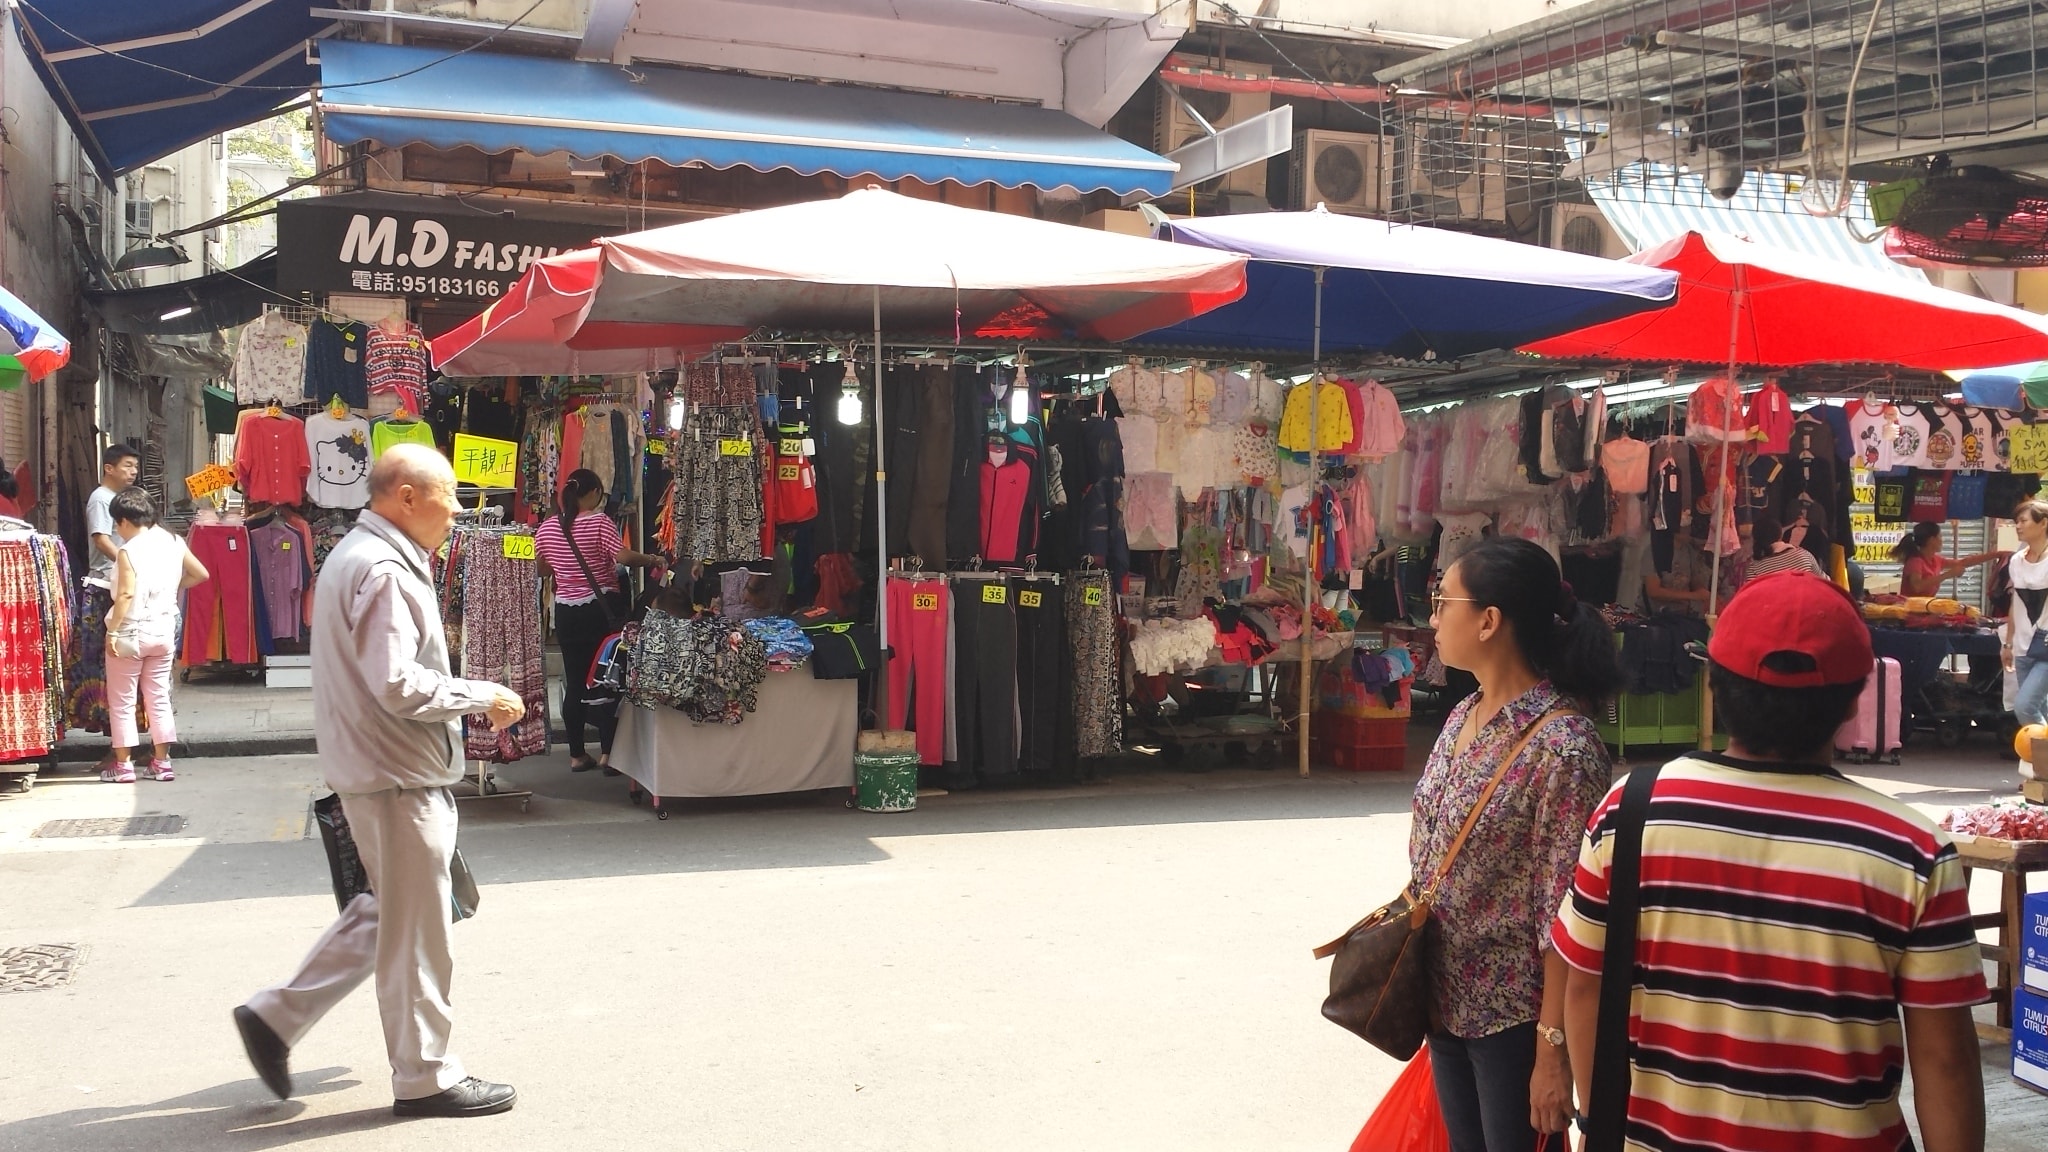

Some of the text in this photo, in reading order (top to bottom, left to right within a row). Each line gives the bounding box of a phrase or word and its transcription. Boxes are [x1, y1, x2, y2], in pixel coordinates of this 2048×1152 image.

[339, 214, 449, 268] M.D
[461, 447, 513, 478] 平靚正
[781, 468, 798, 478] 25
[510, 541, 533, 557] 40
[988, 590, 1001, 600] 35
[1023, 594, 1039, 605] 35
[1087, 592, 1100, 602] 40
[916, 598, 930, 607] 30
[2023, 1018, 2048, 1036] CITRUS
